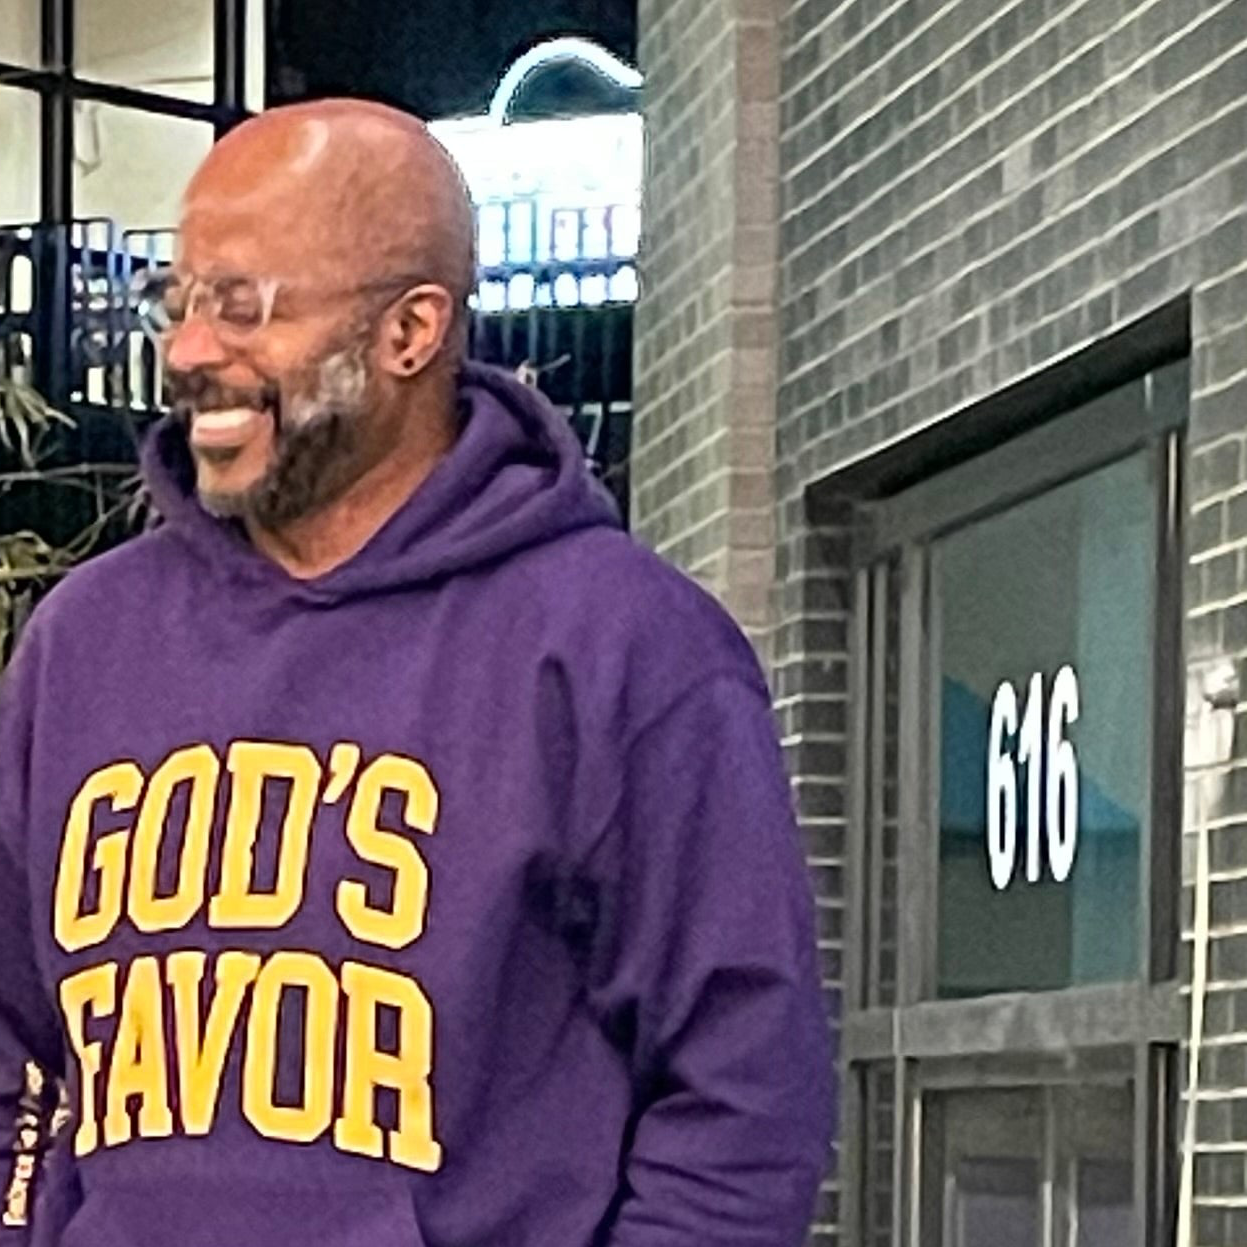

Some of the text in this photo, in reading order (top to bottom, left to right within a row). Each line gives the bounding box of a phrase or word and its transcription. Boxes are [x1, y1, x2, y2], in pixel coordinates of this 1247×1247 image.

[54, 739, 440, 952] GOD'S
[987, 664, 1079, 890] 616
[59, 950, 444, 1173] FAVOR
